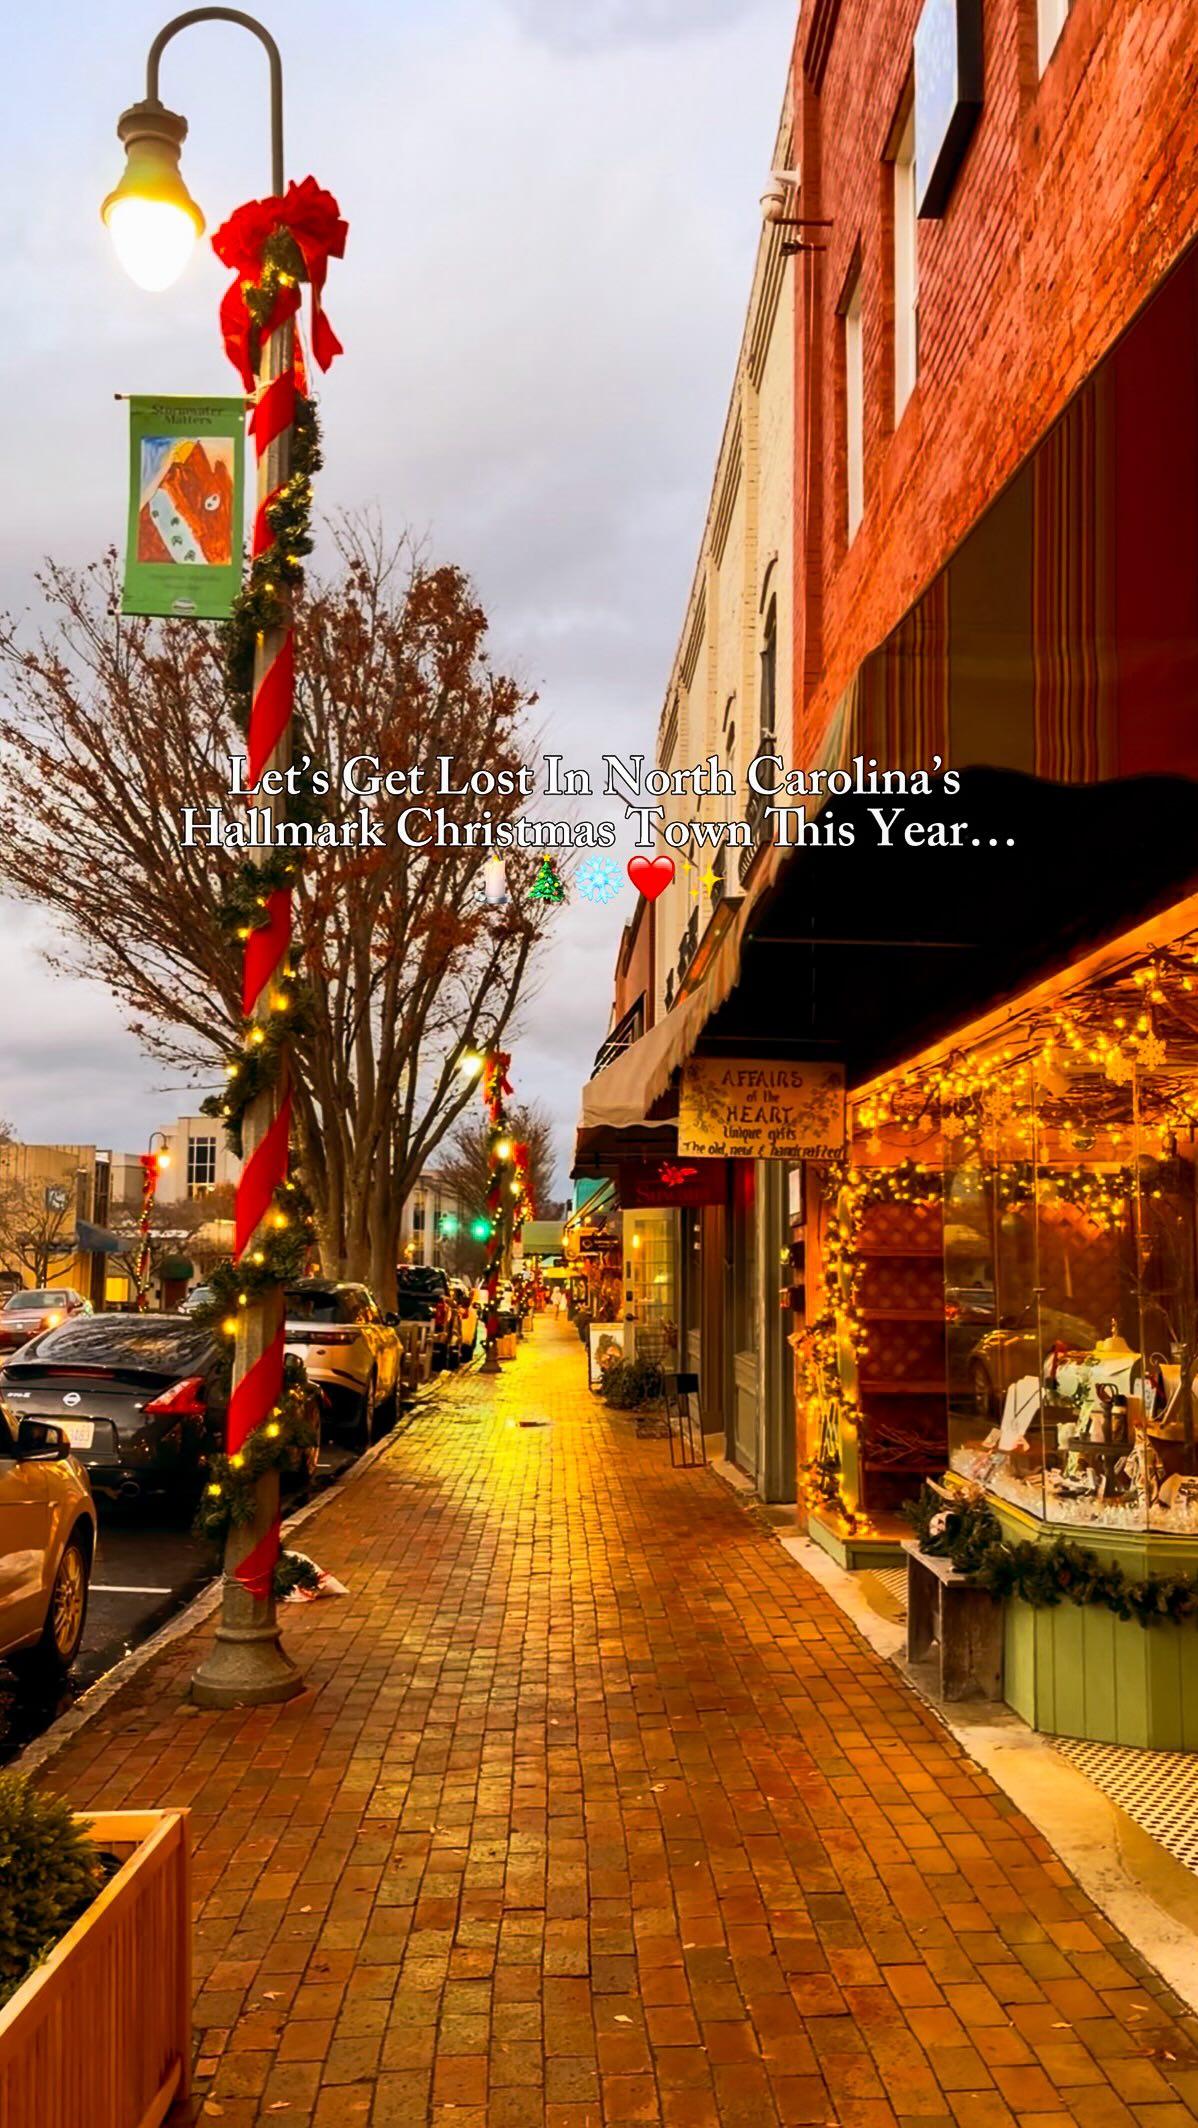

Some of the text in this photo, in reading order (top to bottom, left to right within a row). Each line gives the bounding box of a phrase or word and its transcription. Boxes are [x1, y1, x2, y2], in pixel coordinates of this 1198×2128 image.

[164, 414, 212, 425] Matters
[721, 1070, 804, 1088] AFFAIRS
[746, 1090, 780, 1103] of the
[726, 1106, 794, 1124] HEART
[723, 1126, 797, 1144] Unique gifts
[683, 1141, 706, 1154] The
[708, 1141, 729, 1157] old,
[730, 1145, 753, 1156] new
[770, 1143, 845, 1159] handcrafted
